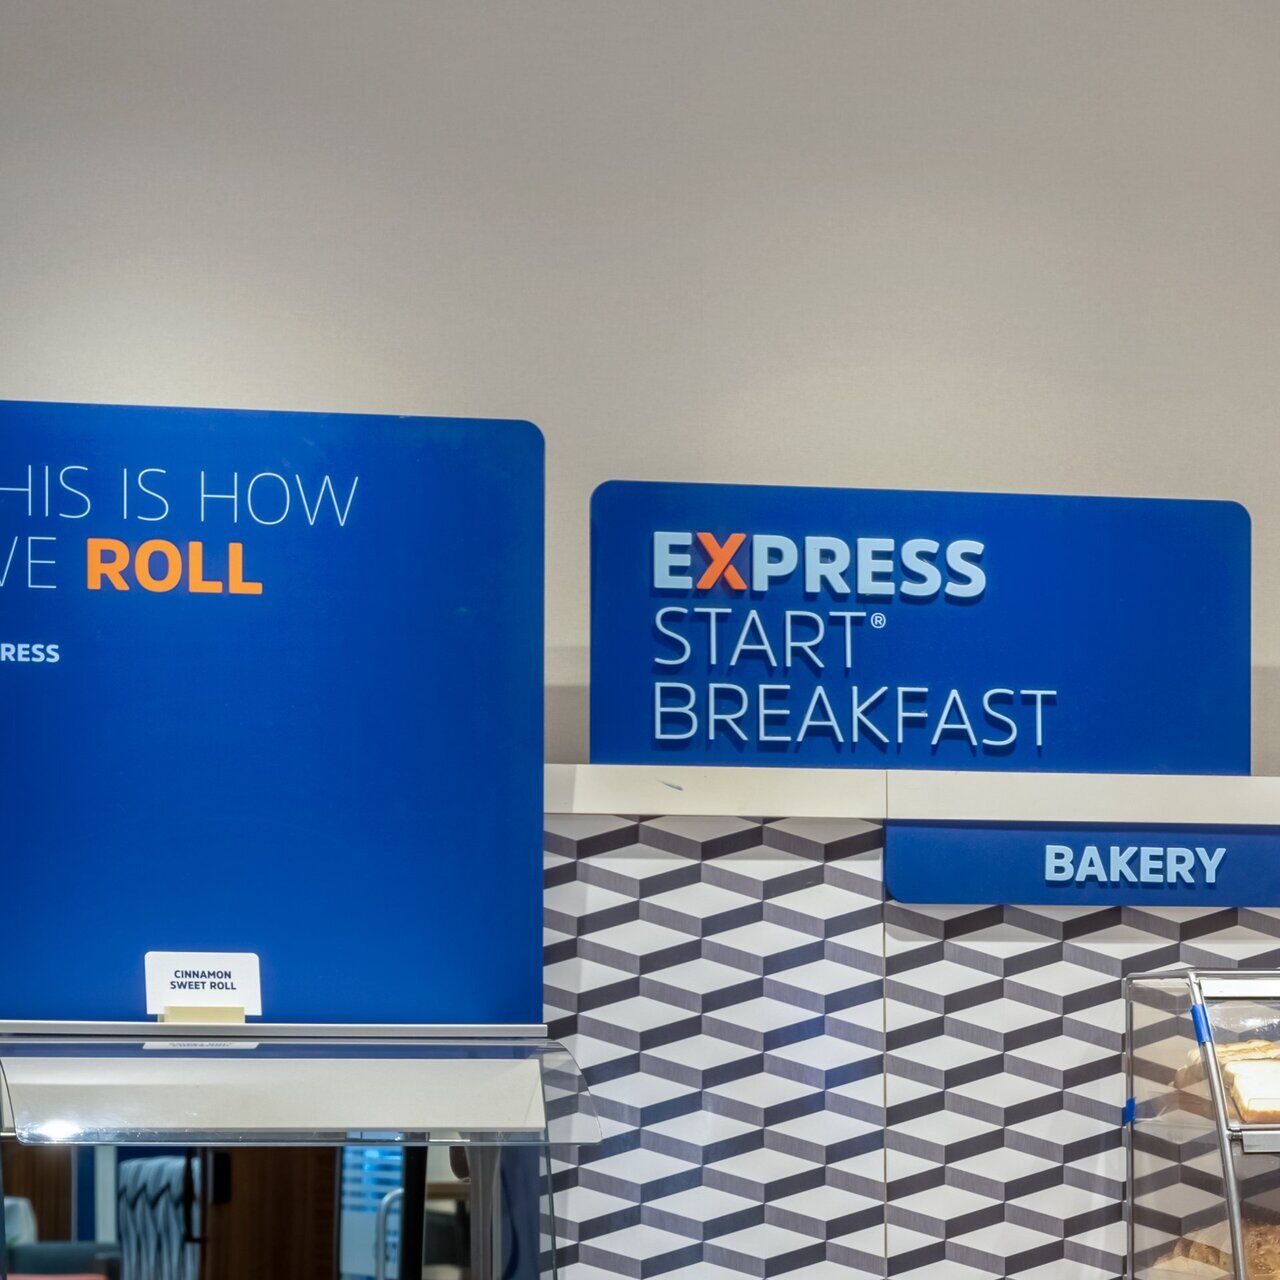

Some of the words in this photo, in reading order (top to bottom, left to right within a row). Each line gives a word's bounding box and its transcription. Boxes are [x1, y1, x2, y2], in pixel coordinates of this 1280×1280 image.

[123, 467, 169, 521] IS
[200, 470, 359, 527] HOW
[86, 537, 263, 595] ROLL
[653, 531, 986, 598] EXPRESS
[654, 682, 1057, 746] BREAKFAST
[1044, 844, 1227, 884] BAKERY
[170, 980, 207, 990] SWEET
[209, 981, 237, 990] ROLL
[174, 969, 232, 980] CINNAMON
